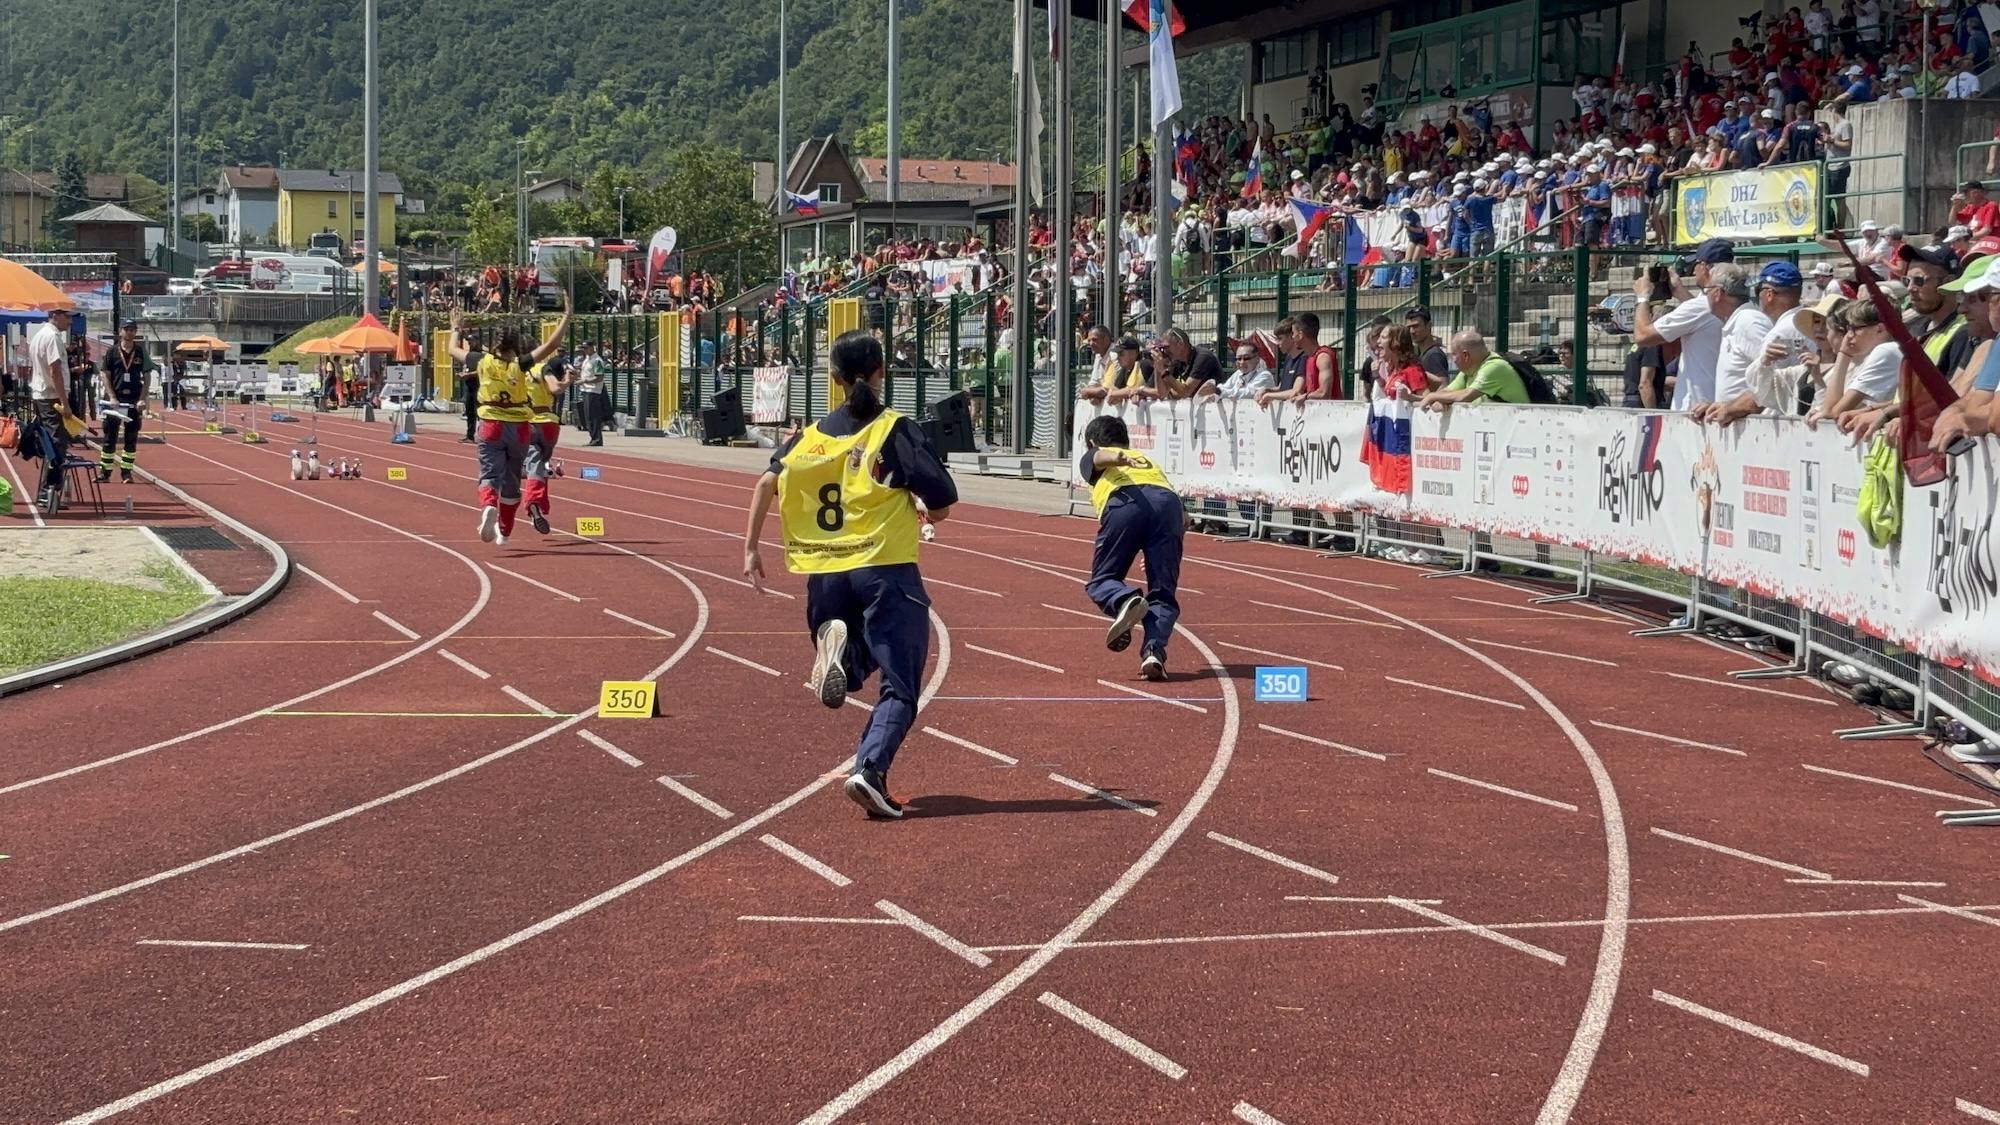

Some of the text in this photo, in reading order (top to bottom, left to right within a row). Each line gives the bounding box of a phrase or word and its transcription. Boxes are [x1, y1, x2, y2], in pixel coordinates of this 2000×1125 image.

[1731, 184, 1758, 202] DHZ
[1743, 206, 1780, 230] Lapáš
[252, 371, 257, 379] 1
[398, 372, 404, 380] 2
[1277, 428, 1342, 485] TRENTINO
[1598, 446, 1664, 527] TRENTINO
[817, 482, 844, 532] 8
[580, 521, 601, 532] 365
[1260, 674, 1301, 693] 350
[605, 688, 647, 710] 350
